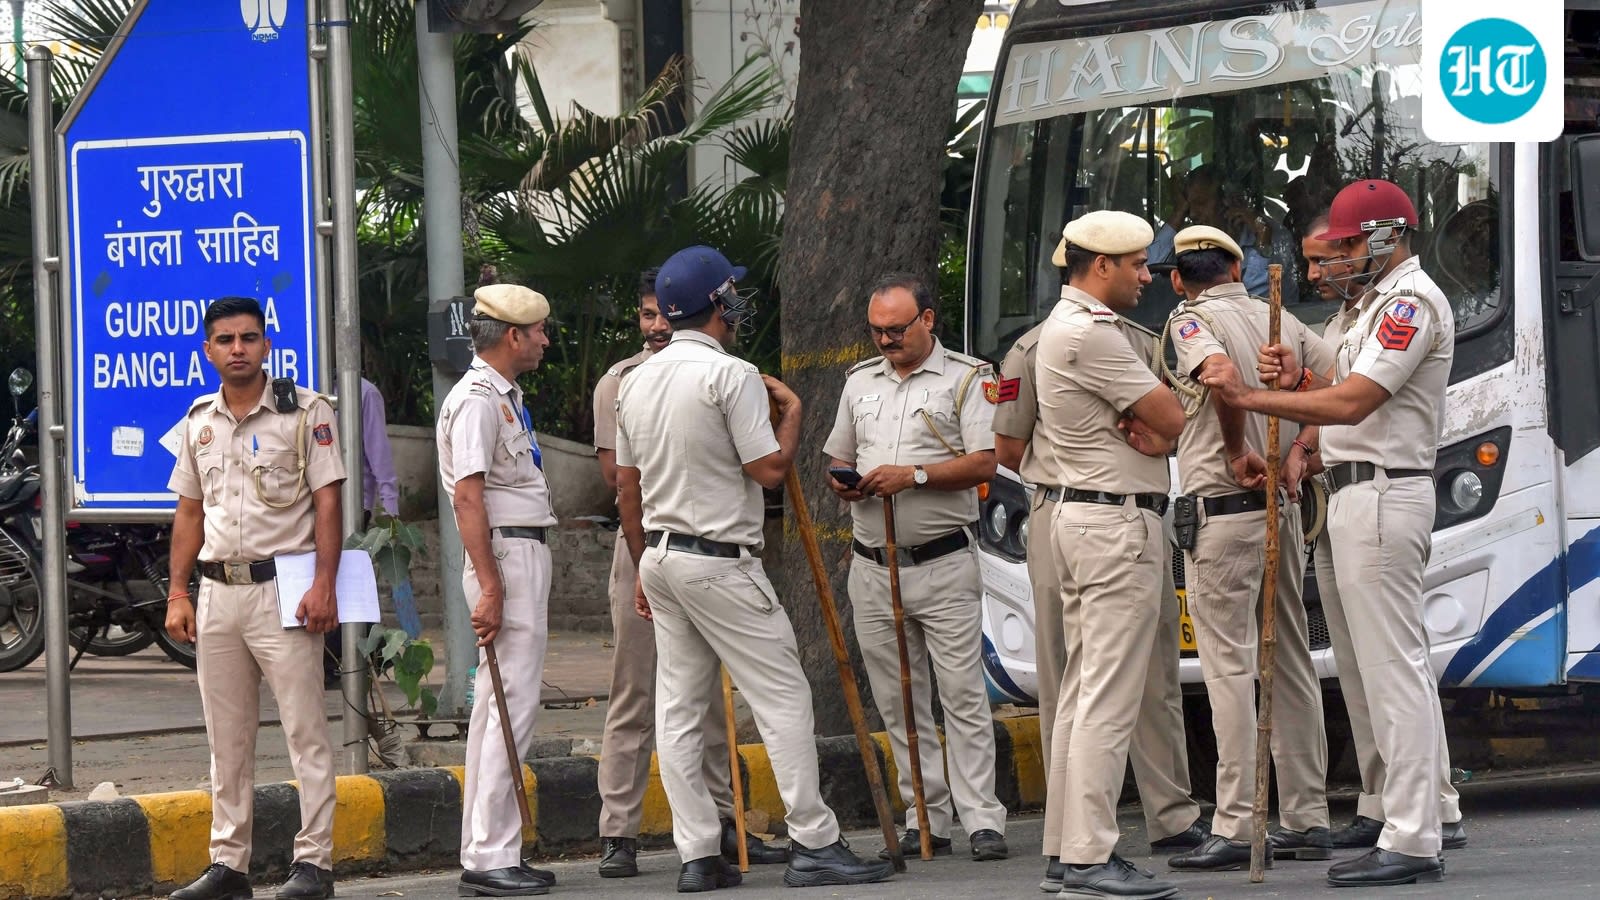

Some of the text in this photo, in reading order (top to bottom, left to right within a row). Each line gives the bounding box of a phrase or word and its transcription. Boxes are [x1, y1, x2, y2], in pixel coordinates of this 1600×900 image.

[1003, 14, 1285, 117] HANS
[137, 163, 243, 218] गुरुद्वारा
[104, 211, 280, 268] बंगला साहिब
[105, 297, 280, 338] GURUDA
[94, 348, 299, 389] BANGLA HIB
